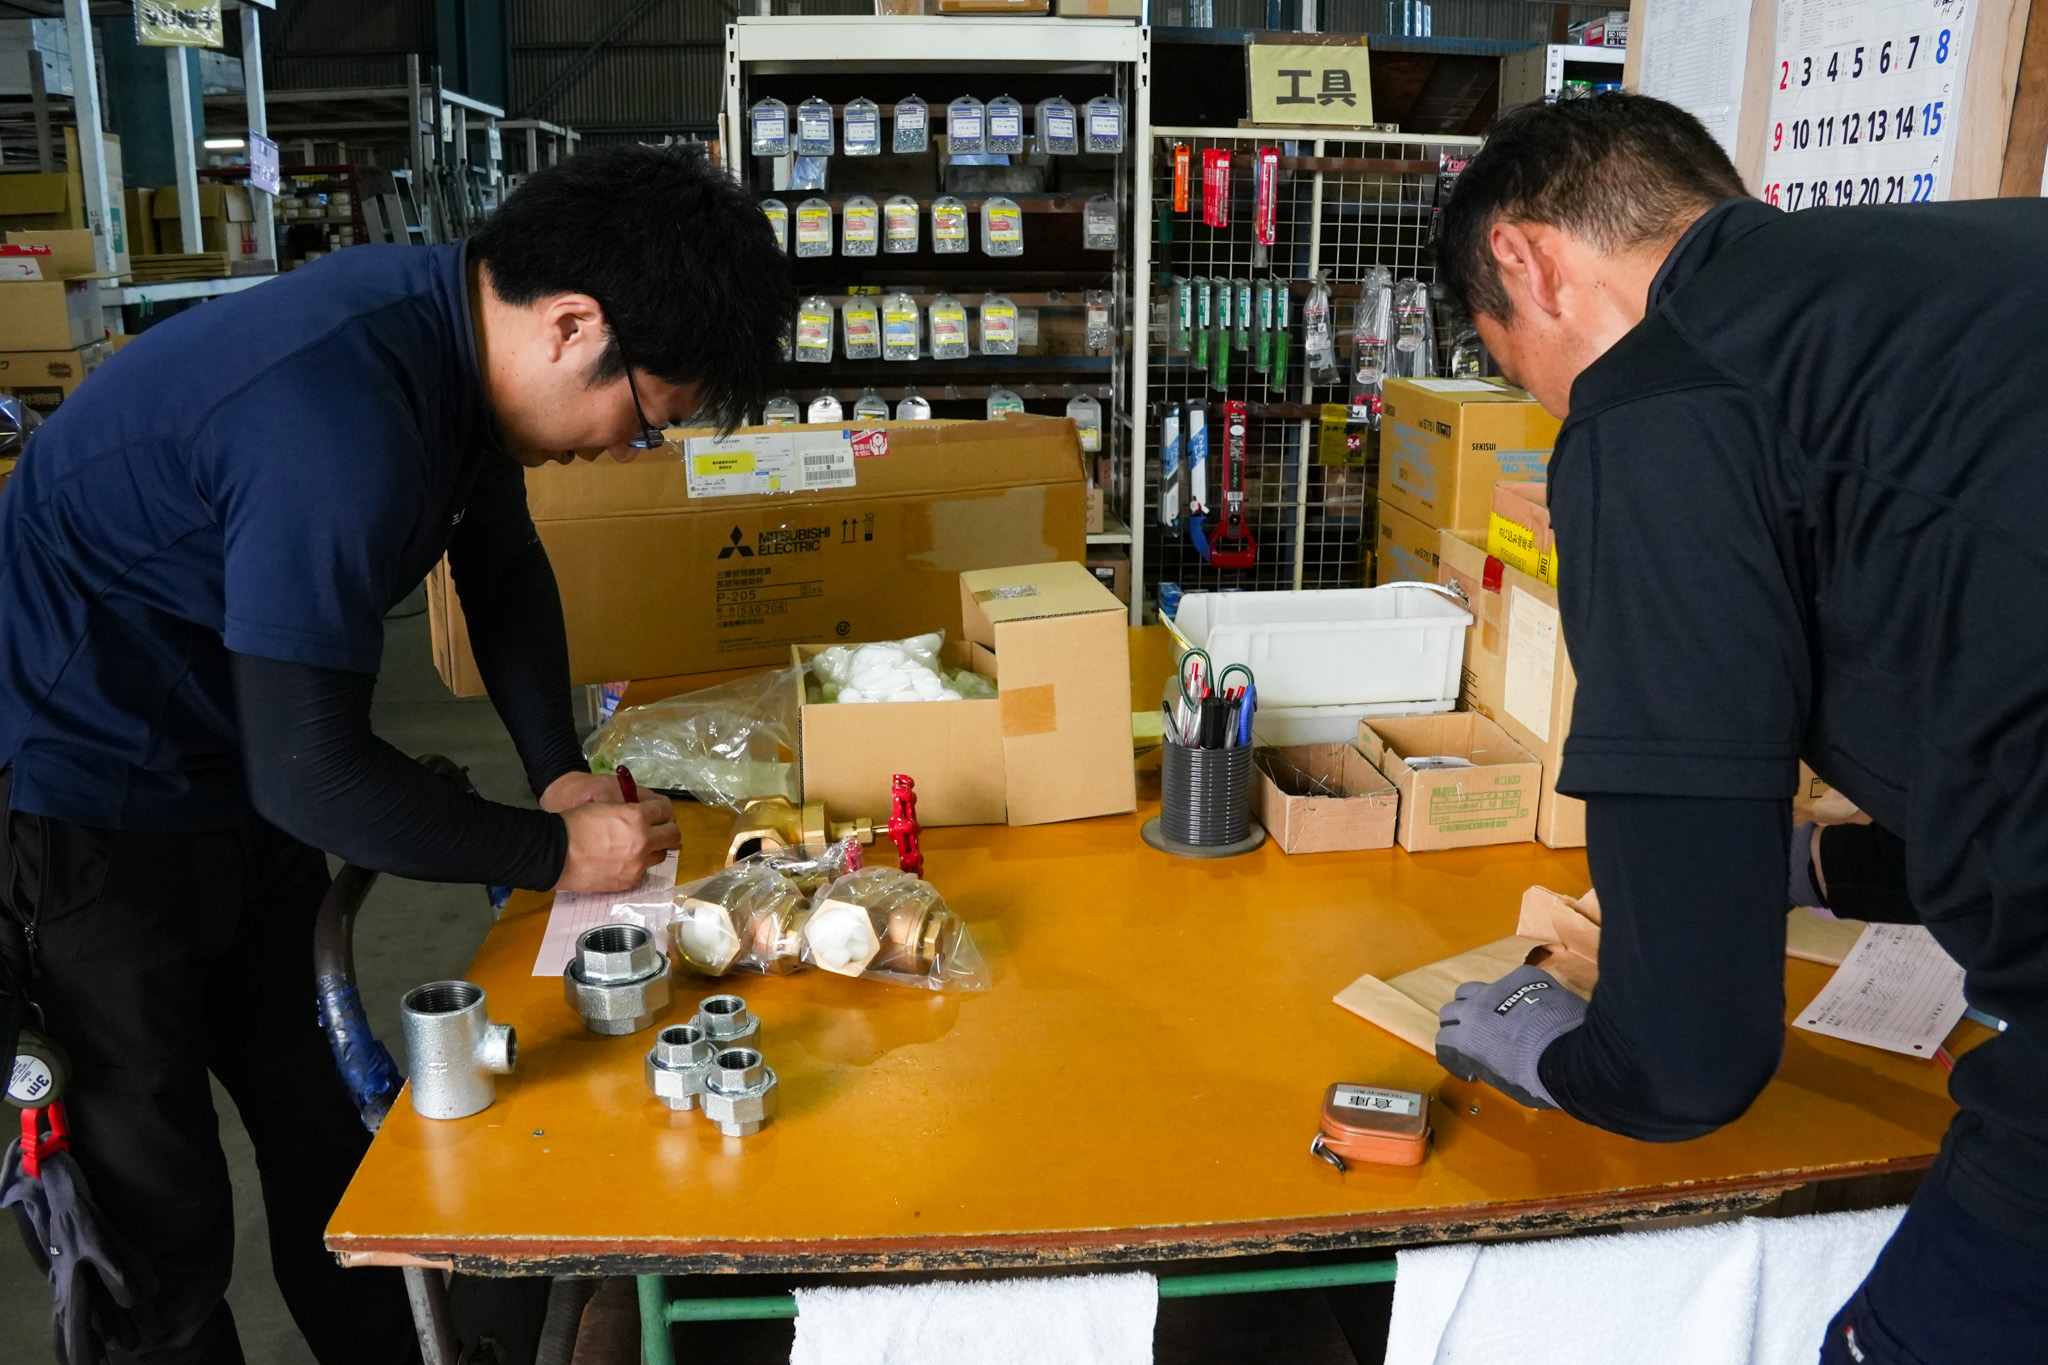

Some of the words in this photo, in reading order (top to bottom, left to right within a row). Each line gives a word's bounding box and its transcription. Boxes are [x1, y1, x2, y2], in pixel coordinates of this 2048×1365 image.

[1780, 61, 1789, 90] 2
[1801, 57, 1812, 86] 3
[1827, 52, 1838, 82] 4
[1852, 47, 1864, 78] 5
[1880, 41, 1892, 74] 6
[1907, 35, 1920, 69] 7
[1935, 29, 1950, 64] 8
[1276, 69, 1357, 107] 工具
[1773, 123, 1783, 151] 9
[1792, 119, 1810, 149] 10
[1817, 116, 1834, 147] 11
[1842, 113, 1860, 145] 12
[1868, 110, 1887, 142] 13
[1895, 106, 1914, 139] 14
[1923, 101, 1944, 136] 15
[1764, 183, 1780, 207] 16
[1786, 182, 1804, 211] 17
[1810, 181, 1828, 207] 18
[1834, 179, 1853, 207] 19
[1859, 177, 1880, 206] 20
[1885, 176, 1904, 204] 21
[1911, 173, 1933, 203] 22
[1472, 443, 1496, 451] SEKISUI
[758, 526, 830, 545] MITSUBISHI
[758, 540, 821, 556] ELECTRIC
[716, 590, 756, 603] P-205
[764, 604, 785, 614] 206
[1497, 982, 1549, 1011] TRUSCO
[1523, 996, 1540, 1005] L
[26, 1074, 50, 1096] 3m
[1348, 1096, 1392, 1109] 倉庫
